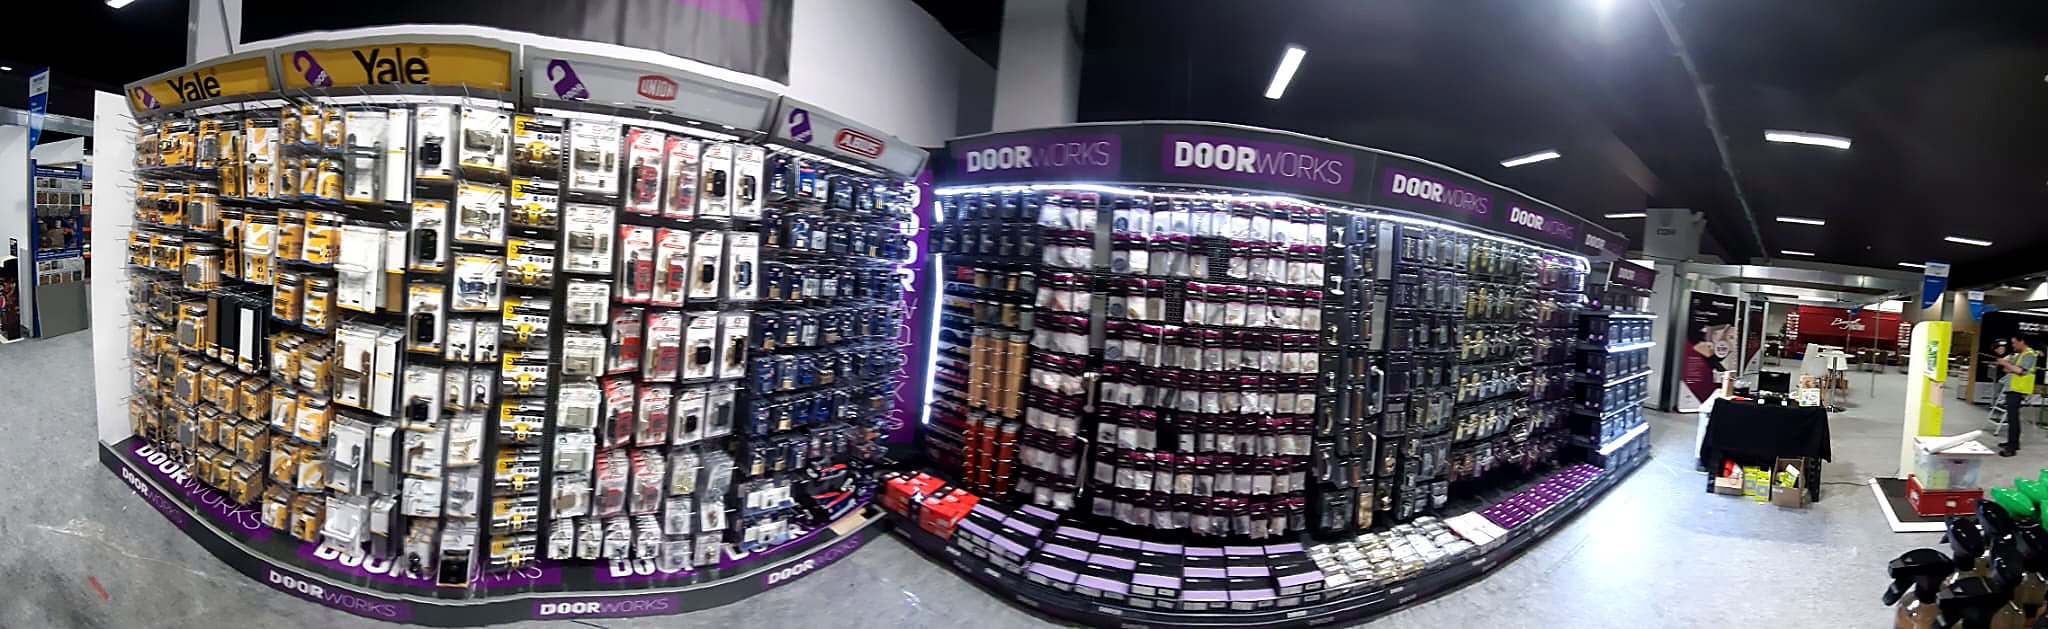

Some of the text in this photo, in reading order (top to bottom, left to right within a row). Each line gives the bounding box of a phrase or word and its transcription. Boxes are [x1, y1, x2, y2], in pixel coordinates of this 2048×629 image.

[352, 47, 430, 85] Yale
[167, 72, 222, 103] Yale
[641, 78, 675, 97] UNION
[966, 141, 1111, 174] DOORWORKS
[1174, 140, 1343, 186] DOORWORKS
[1392, 173, 1489, 214] DOORWORKS
[269, 569, 397, 618] DOORWORKS
[540, 598, 669, 616] DOORWORKS
